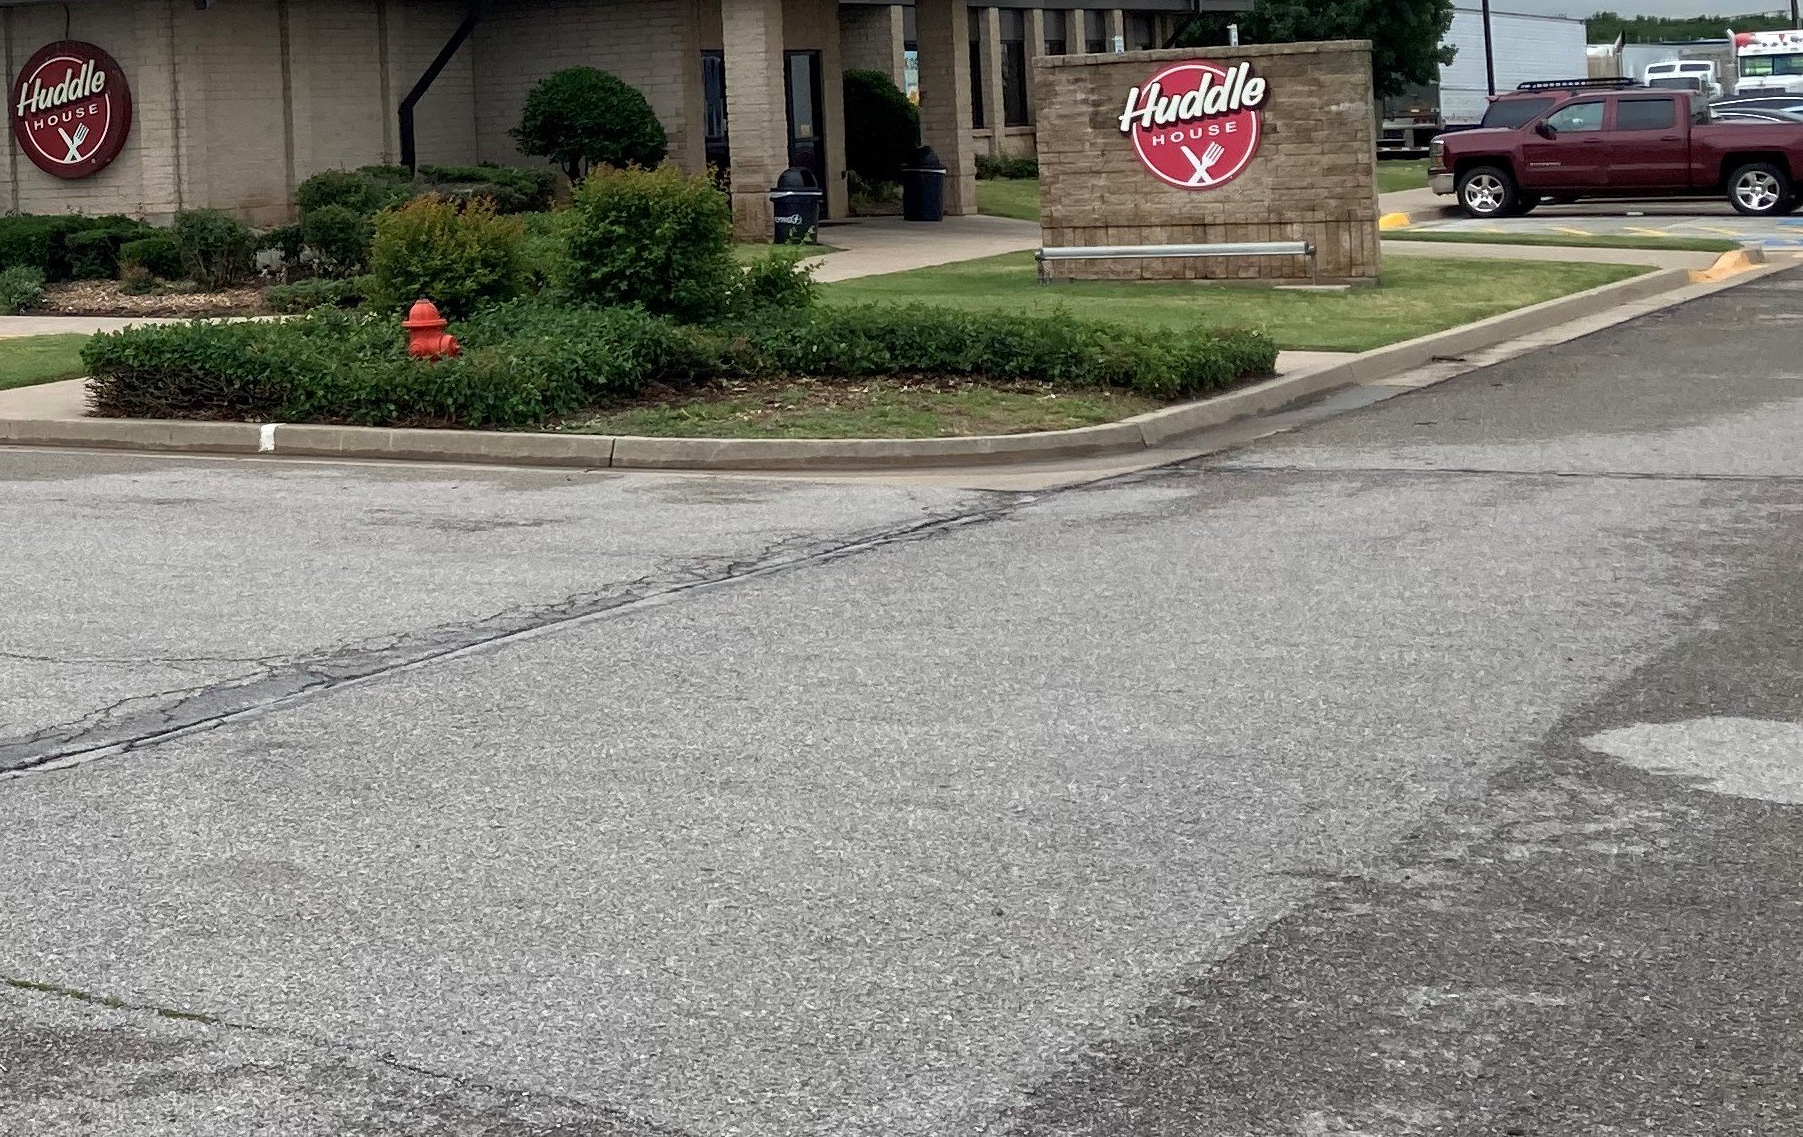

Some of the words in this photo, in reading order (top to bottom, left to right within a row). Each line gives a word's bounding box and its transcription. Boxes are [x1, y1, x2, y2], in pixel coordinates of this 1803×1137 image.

[17, 59, 106, 117] Huddle
[1118, 62, 1267, 132] Huddle
[33, 103, 98, 131] HOUSE
[1152, 121, 1238, 147] HOUSE
